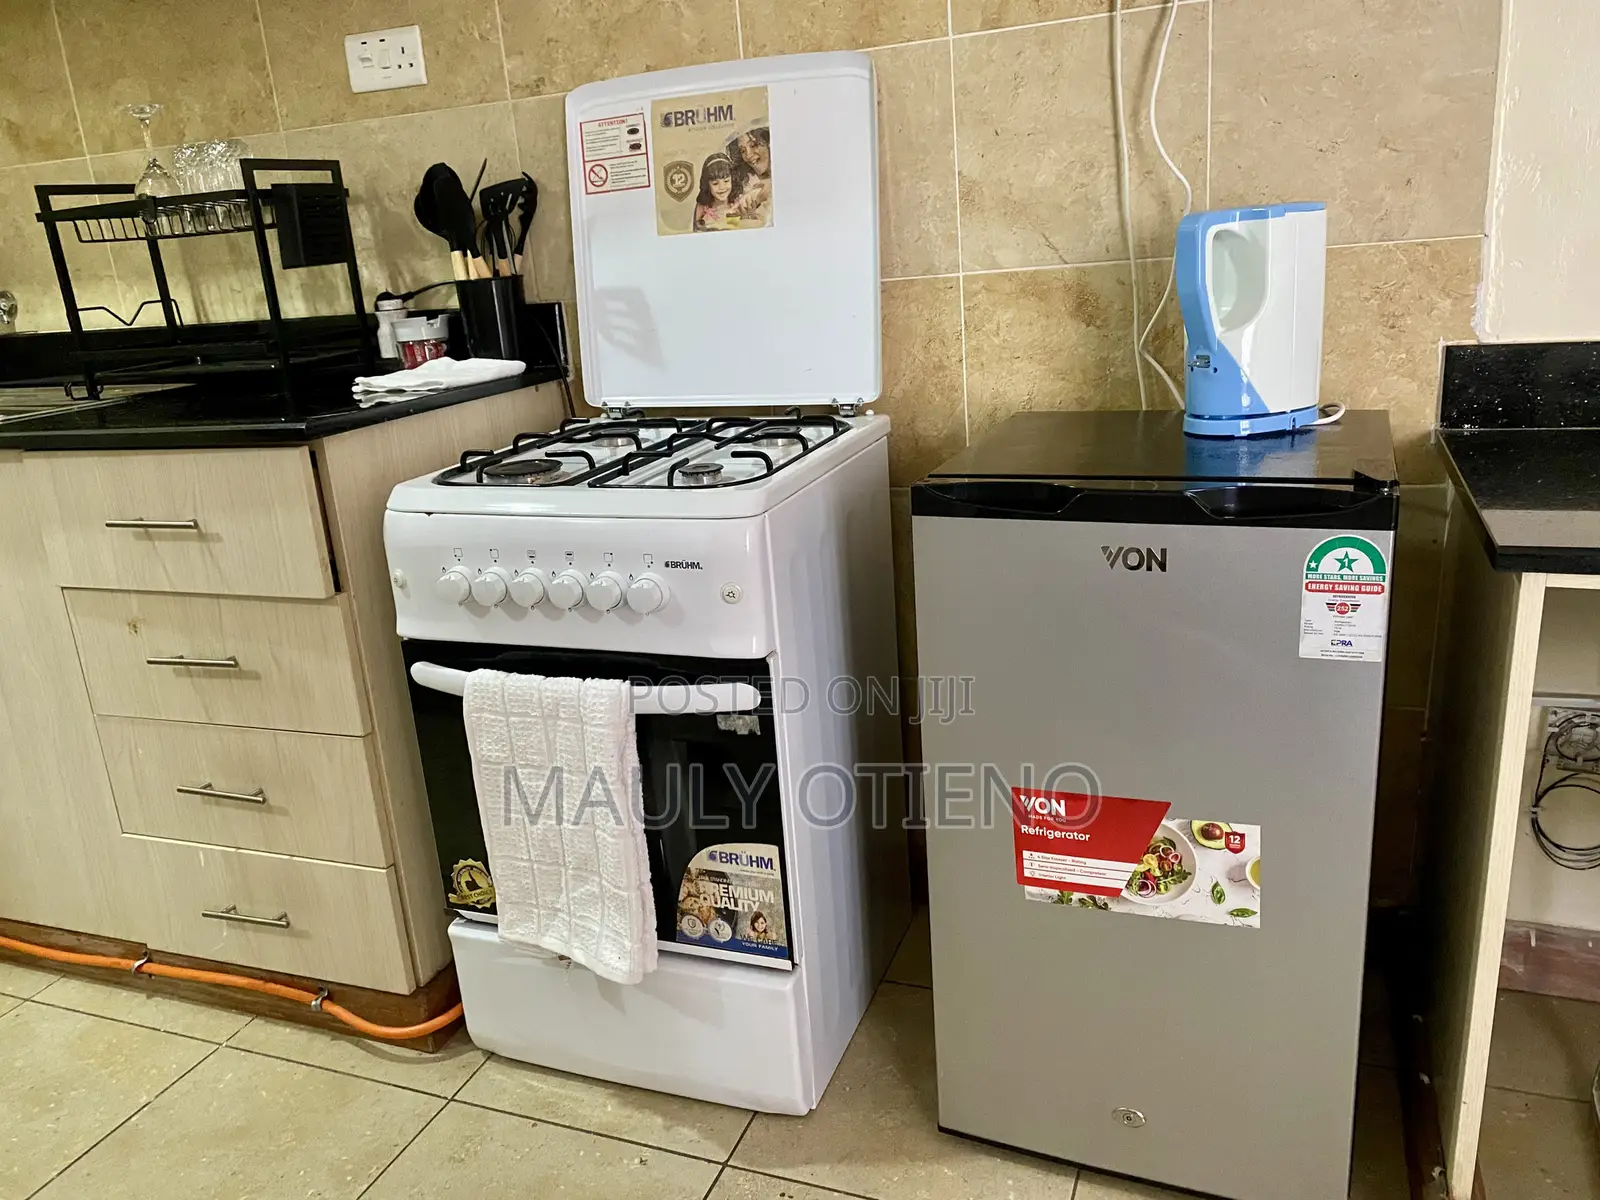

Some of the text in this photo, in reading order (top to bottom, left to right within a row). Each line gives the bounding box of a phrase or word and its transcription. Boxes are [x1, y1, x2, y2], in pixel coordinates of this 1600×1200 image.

[672, 173, 685, 186] 12
[1101, 546, 1167, 572] VON
[1308, 583, 1383, 593] ENERGY SAVING GUIDE
[1020, 795, 1066, 816] VON
[1021, 824, 1091, 841] Refrigerator
[1229, 835, 1241, 844] 12
[700, 880, 774, 904] PREMIUM
[700, 893, 760, 912] QUALITY
